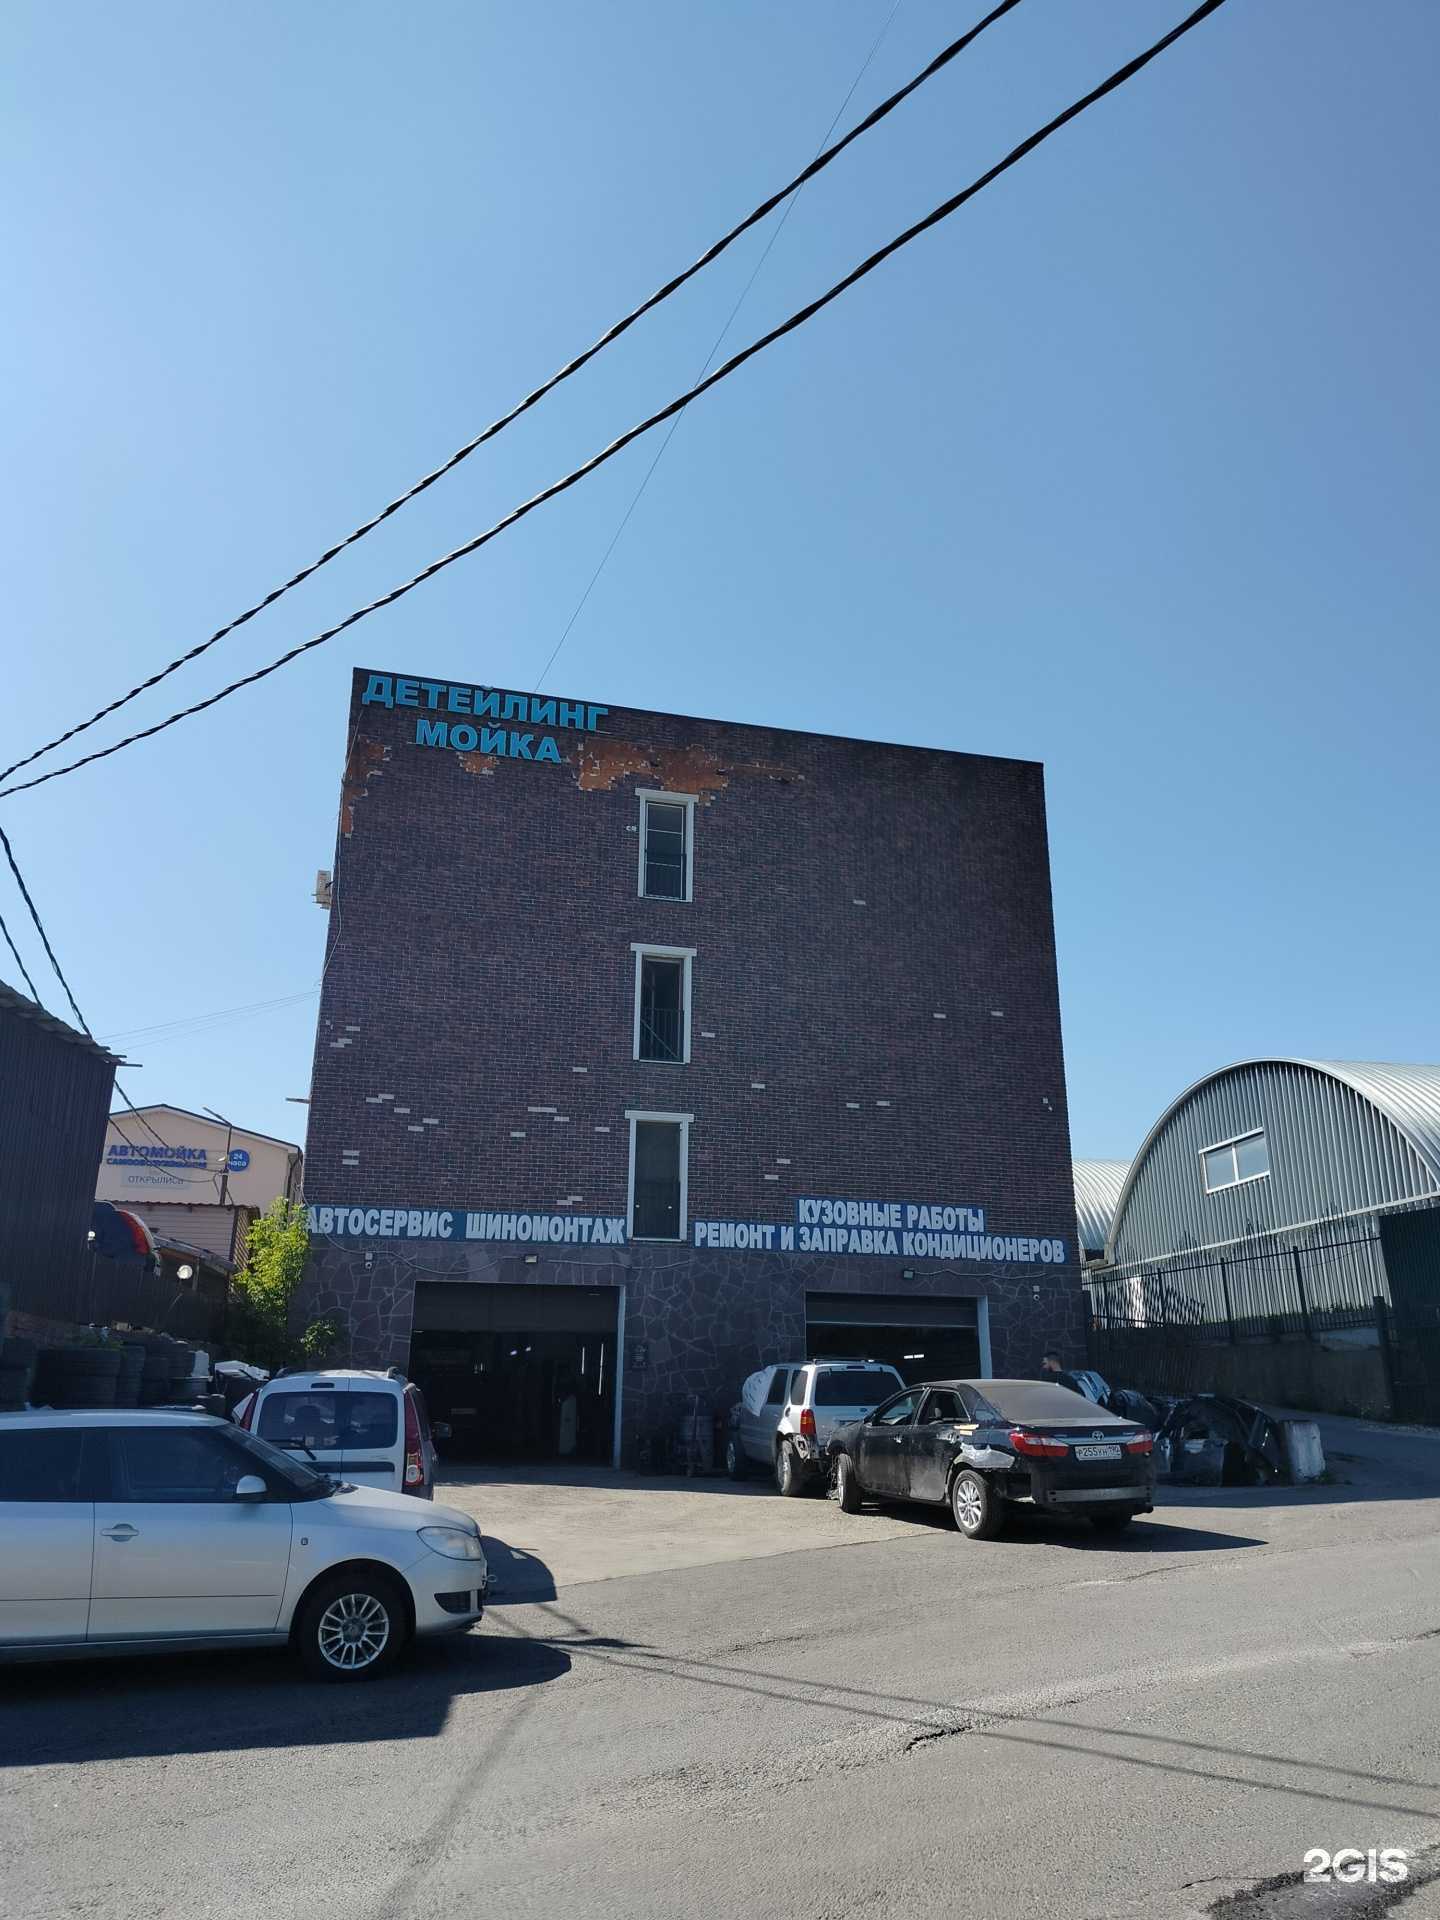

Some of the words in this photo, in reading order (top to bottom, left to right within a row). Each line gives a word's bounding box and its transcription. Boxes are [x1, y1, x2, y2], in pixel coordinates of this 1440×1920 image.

[362, 674, 608, 731] ДЕТЕЙЛИНГ
[415, 719, 561, 763] МОЙКА
[108, 1145, 207, 1160] АВТОМОЙКА
[305, 1206, 453, 1238] АВТОСЕРВИС
[466, 1212, 625, 1244] ШИНОМОНТАЖ
[799, 1199, 902, 1228] КУЗОВНЫЕ
[907, 1205, 985, 1232] РАБОТЫ
[695, 1222, 775, 1249] РЕМОНТ
[781, 1227, 795, 1250] И
[799, 1226, 899, 1255] ЗАПРАВКА
[903, 1231, 1065, 1263] КОНДИЦИОНЕРОВ
